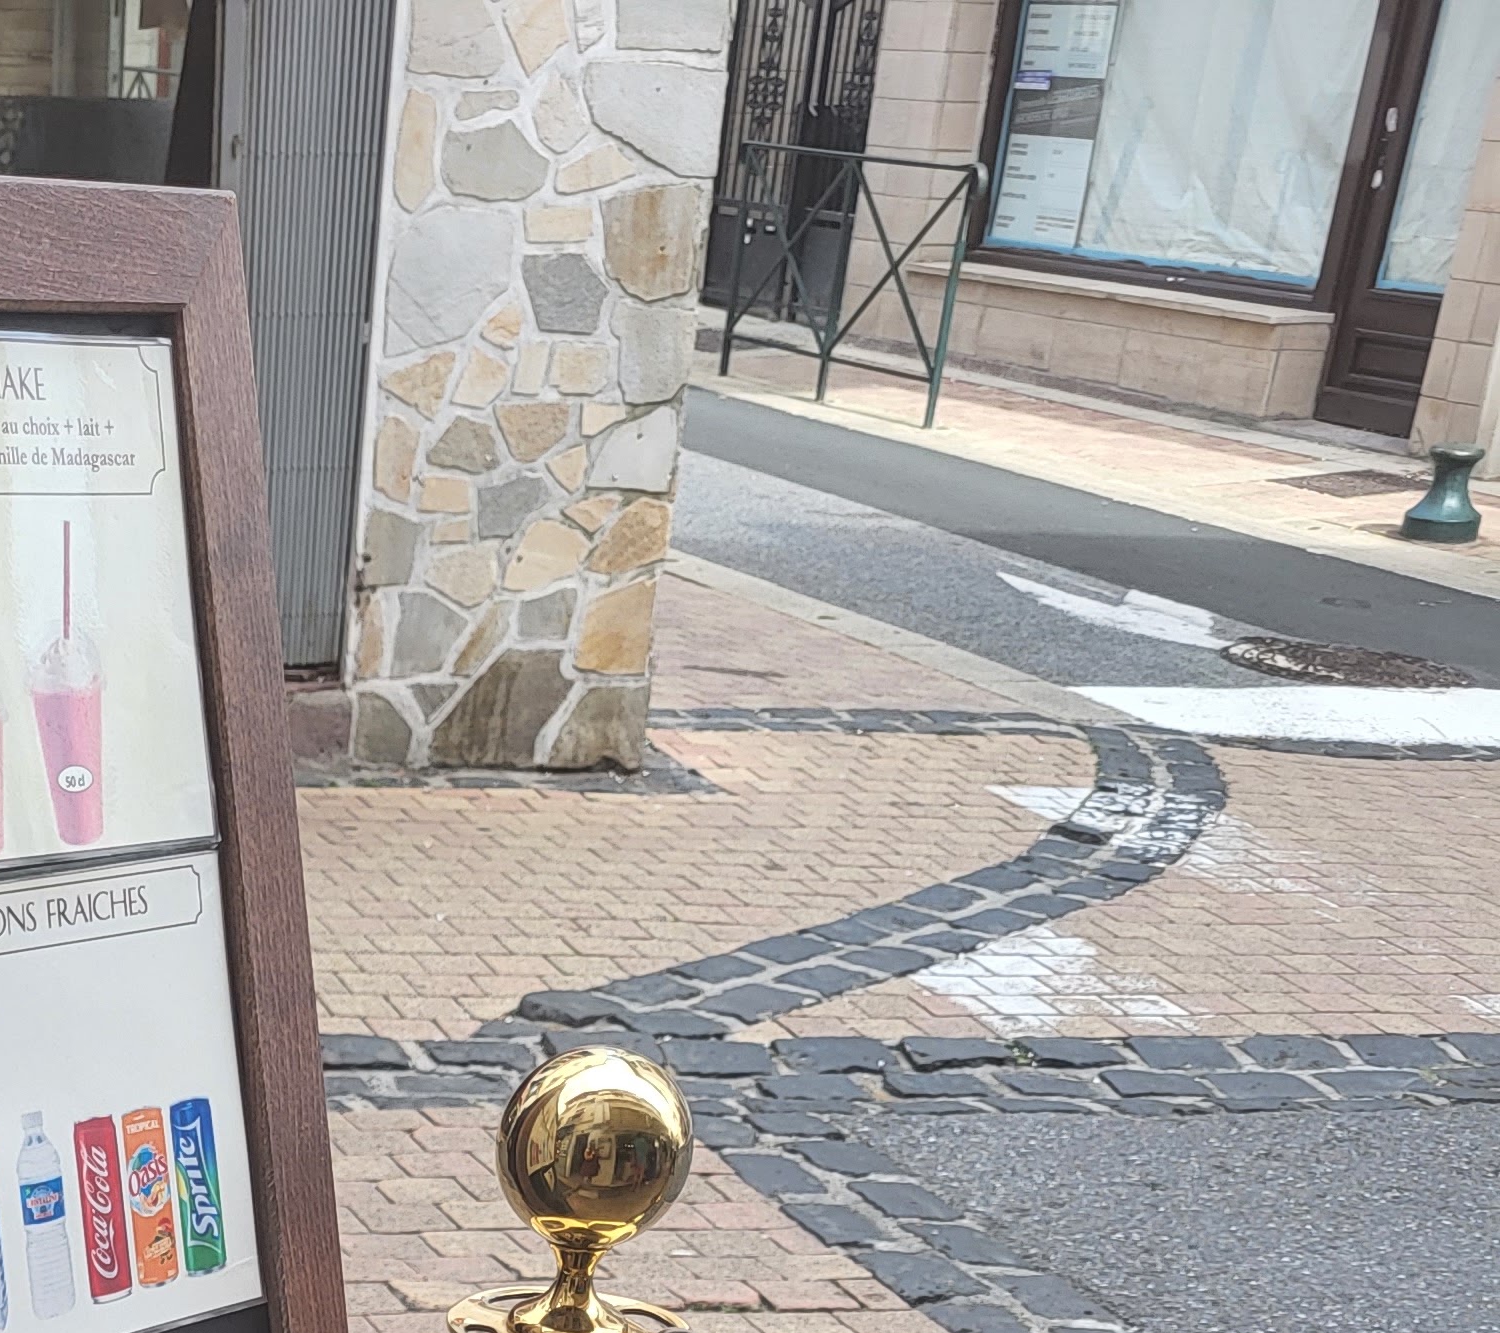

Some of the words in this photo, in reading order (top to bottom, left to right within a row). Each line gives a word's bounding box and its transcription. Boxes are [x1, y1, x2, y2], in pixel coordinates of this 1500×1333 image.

[1, 421, 19, 435] au
[22, 416, 60, 435] choix
[63, 419, 74, 435] +
[77, 418, 100, 437] lait
[104, 420, 115, 436] +
[31, 447, 48, 466] de
[51, 447, 136, 473] Madagascar
[65, 775, 77, 788] 50
[46, 886, 149, 929] FRAICHES
[128, 1153, 169, 1198] Oasis
[177, 1136, 220, 1240] Sprite
